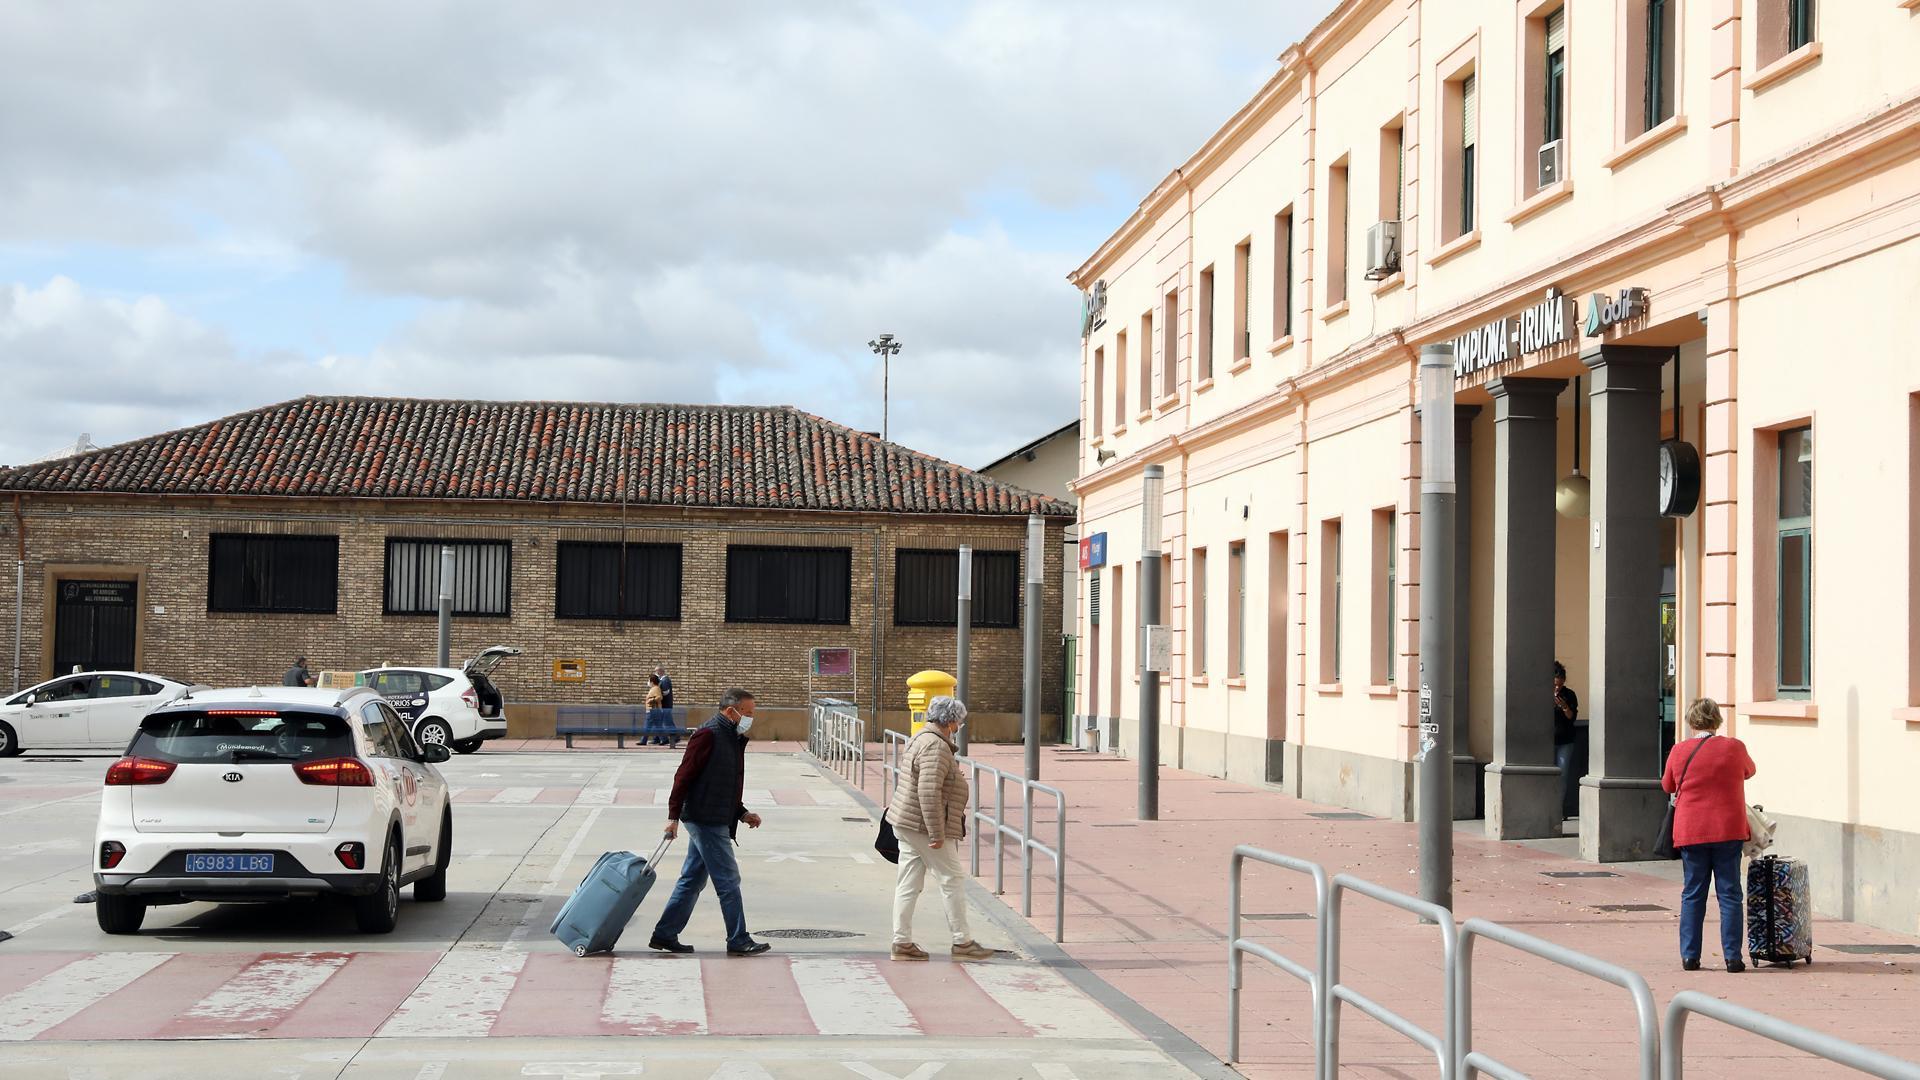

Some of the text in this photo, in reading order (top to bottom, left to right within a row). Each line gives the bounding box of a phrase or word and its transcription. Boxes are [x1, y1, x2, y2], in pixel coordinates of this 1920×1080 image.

[1602, 287, 1634, 325] adif
[1452, 317, 1508, 377] AMPLONA
[196, 856, 235, 870] 6983
[240, 856, 269, 870] LBG
